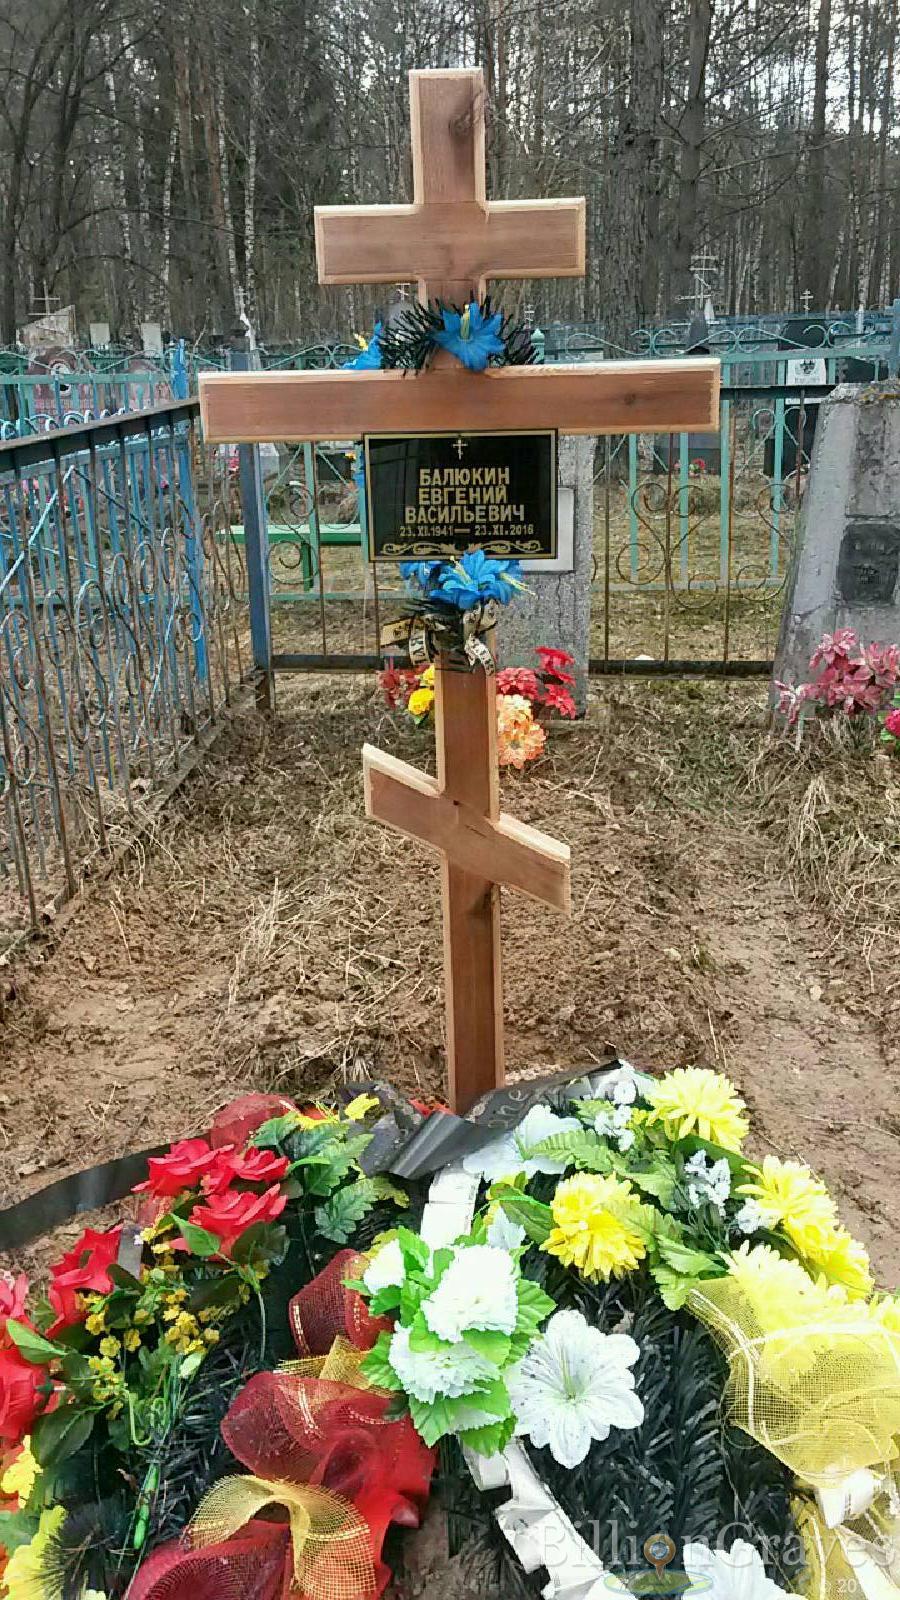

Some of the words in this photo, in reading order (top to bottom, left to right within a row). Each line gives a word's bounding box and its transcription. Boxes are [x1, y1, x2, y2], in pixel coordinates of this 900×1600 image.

[419, 466, 511, 485] БАЛЮКИН
[417, 485, 508, 505] ЕВГЕНИЙ
[404, 504, 526, 525] ВАСИЛЬЕВИЧ
